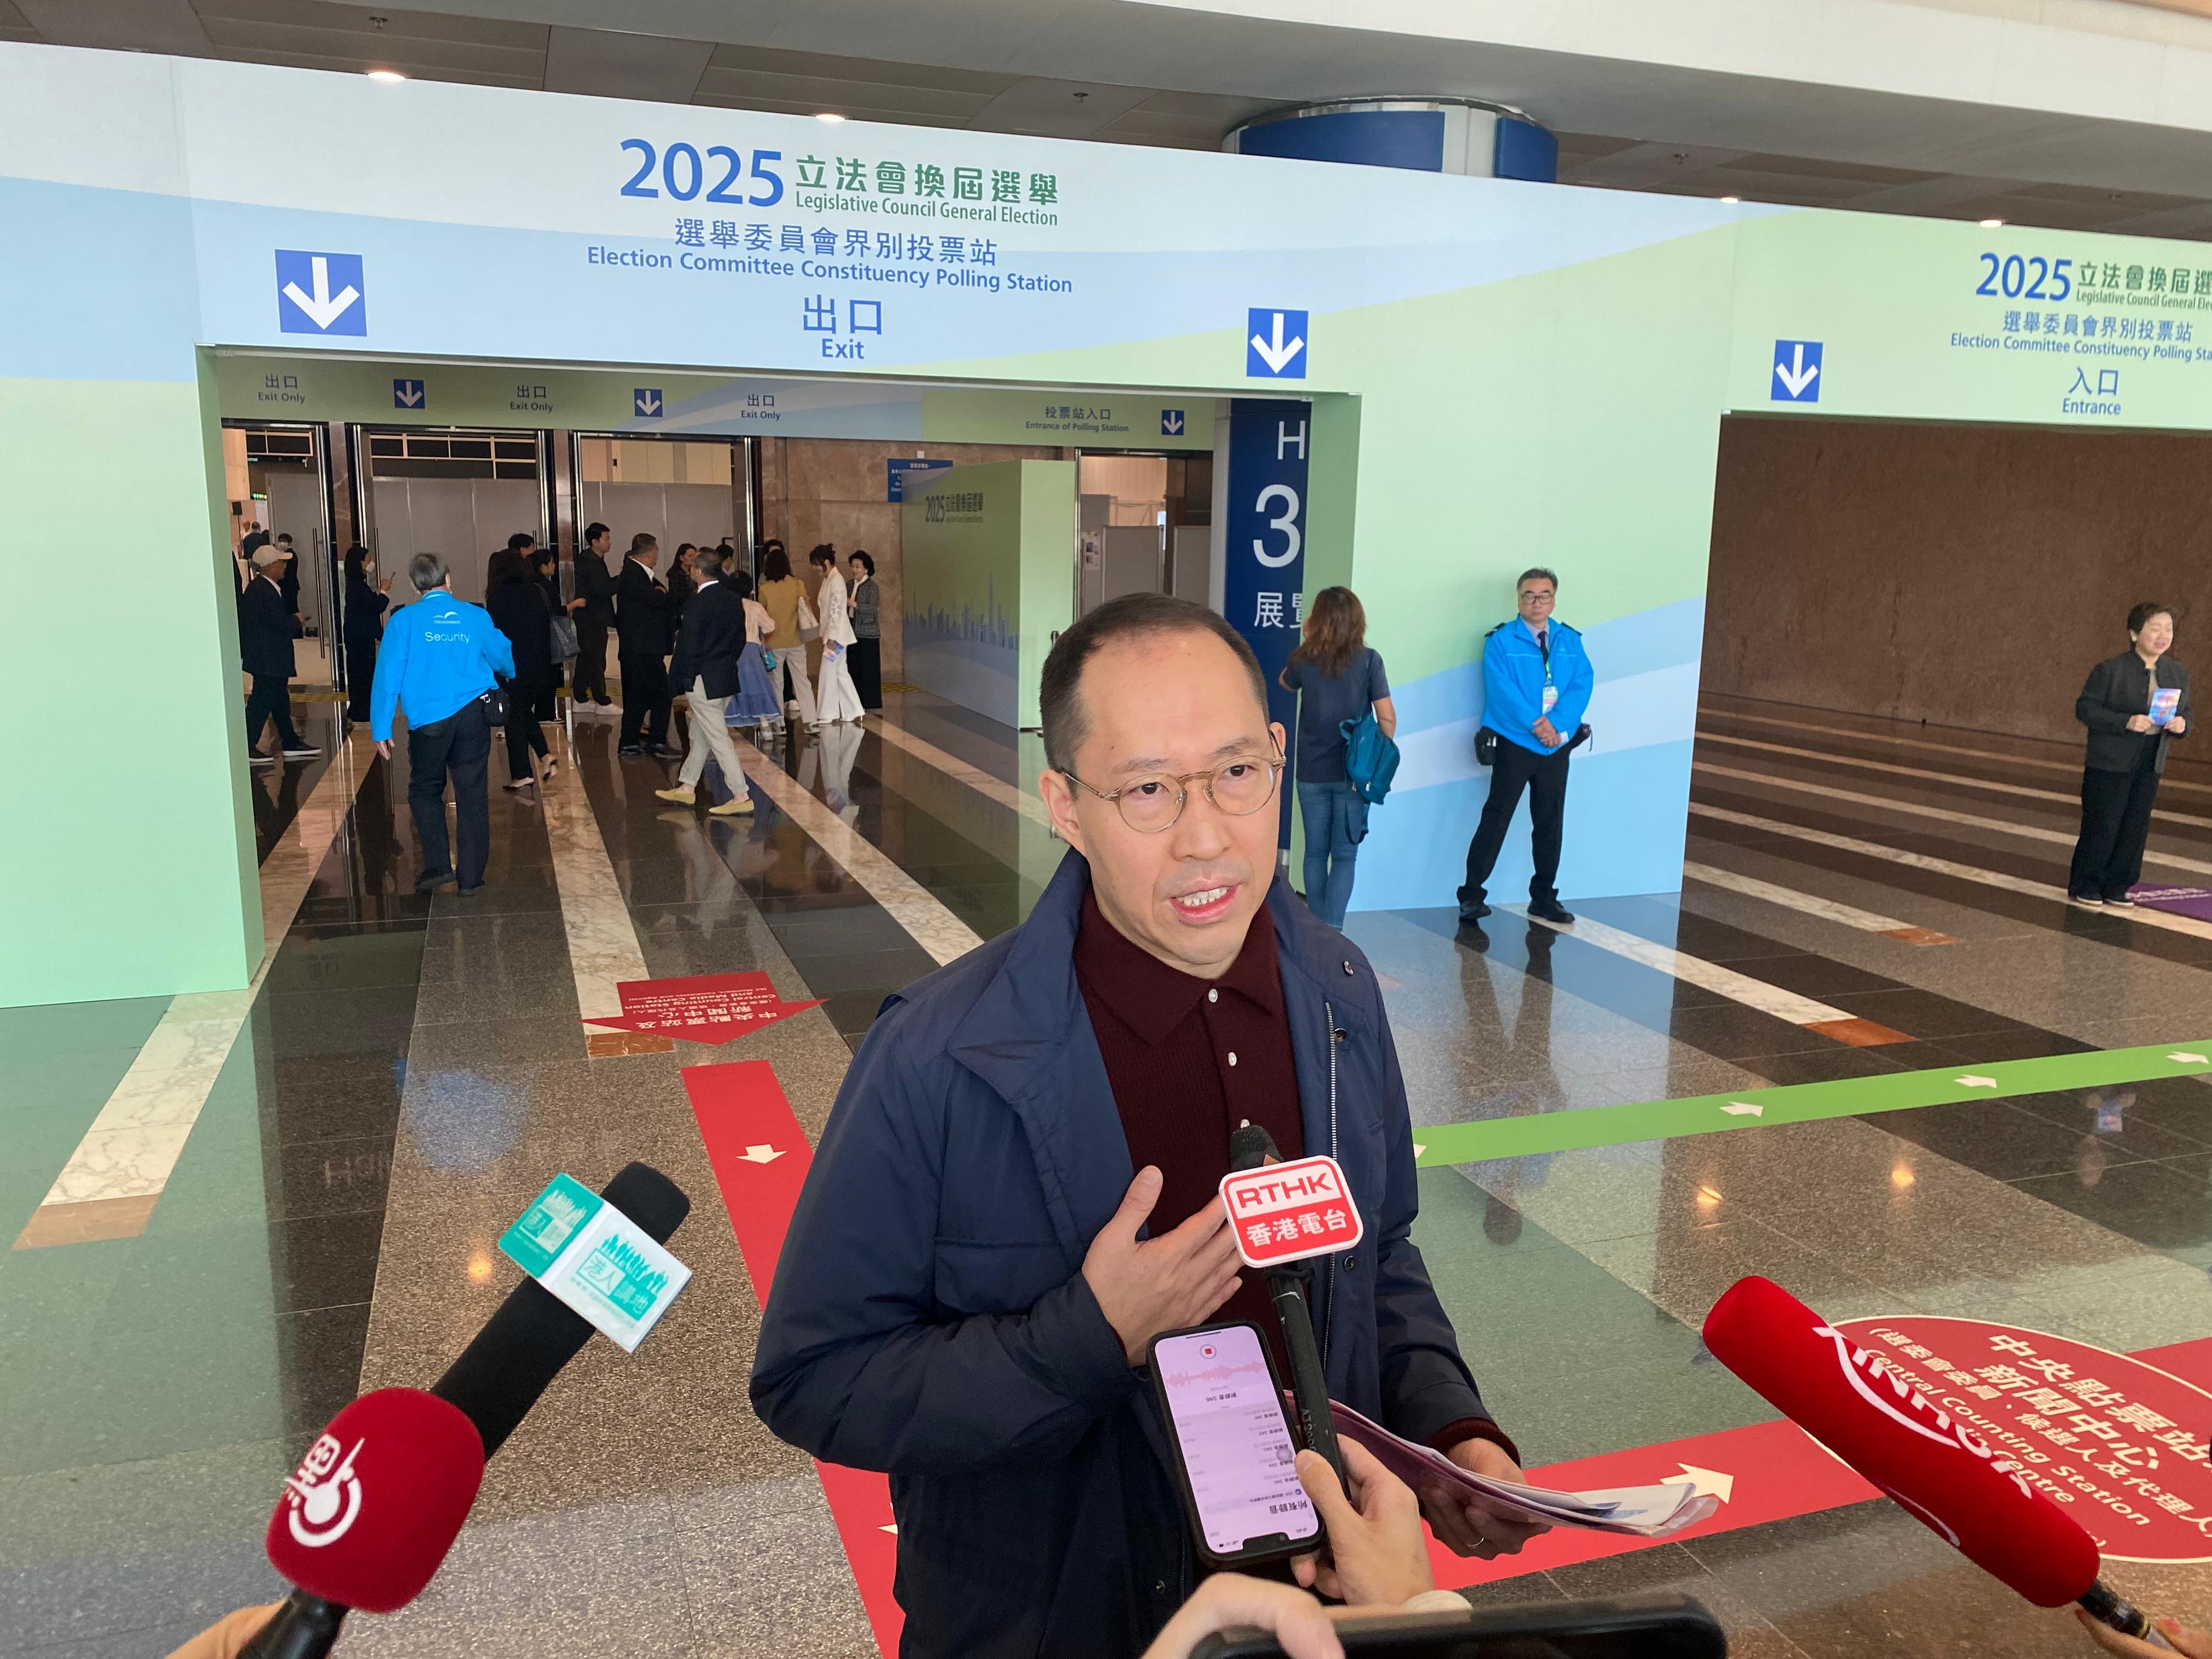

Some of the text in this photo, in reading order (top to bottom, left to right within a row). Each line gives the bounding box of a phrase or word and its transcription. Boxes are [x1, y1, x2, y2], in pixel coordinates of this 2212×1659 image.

[620, 138, 784, 207] 2025
[795, 154, 1058, 206] 立法會換屆選舉
[796, 191, 1058, 225] Legislative Council General Election
[675, 218, 997, 266] 選舉委員會界別投票站
[588, 246, 1073, 292] Election Committee Constituency Polling Station
[1976, 252, 2073, 302] 2025
[2076, 289, 2125, 306] Legislative
[2127, 291, 2159, 307] Council
[2162, 295, 2196, 309] General
[803, 294, 882, 335] 出口
[2002, 310, 2193, 343] 選舉委員會界別投票站
[821, 338, 865, 360] Exit
[1951, 332, 2000, 349] Election
[2004, 335, 2070, 353] Committee
[2074, 340, 2150, 360] Constituency
[2153, 344, 2192, 363] Polling
[266, 374, 297, 389] 出口
[517, 385, 546, 399] 出口
[2068, 366, 2119, 396] 入口
[258, 392, 305, 404] Exit Only
[510, 401, 553, 413] Exit Only
[748, 393, 774, 407] 出口
[1045, 406, 1111, 420] 投票站入口
[2062, 398, 2121, 415] Entrance
[741, 410, 781, 421] Exit Only
[1026, 421, 1060, 430] Entrance
[1073, 423, 1099, 432] Polling
[1102, 424, 1129, 432] Station
[1277, 420, 1306, 460] H
[1253, 484, 1301, 568] 3
[425, 631, 470, 644] Security
[658, 1006, 752, 1019] 新聞中心
[673, 997, 729, 1006] Counting
[635, 1011, 777, 1029] 中央點票站及
[1236, 1172, 1333, 1209] RTHK
[1246, 1208, 1347, 1248] 香港電台
[1989, 1334, 2212, 1469] 中央點票站
[1973, 1364, 2159, 1470] 新聞中心
[1942, 1397, 2051, 1464] Counting
[2051, 1465, 2150, 1526] Station
